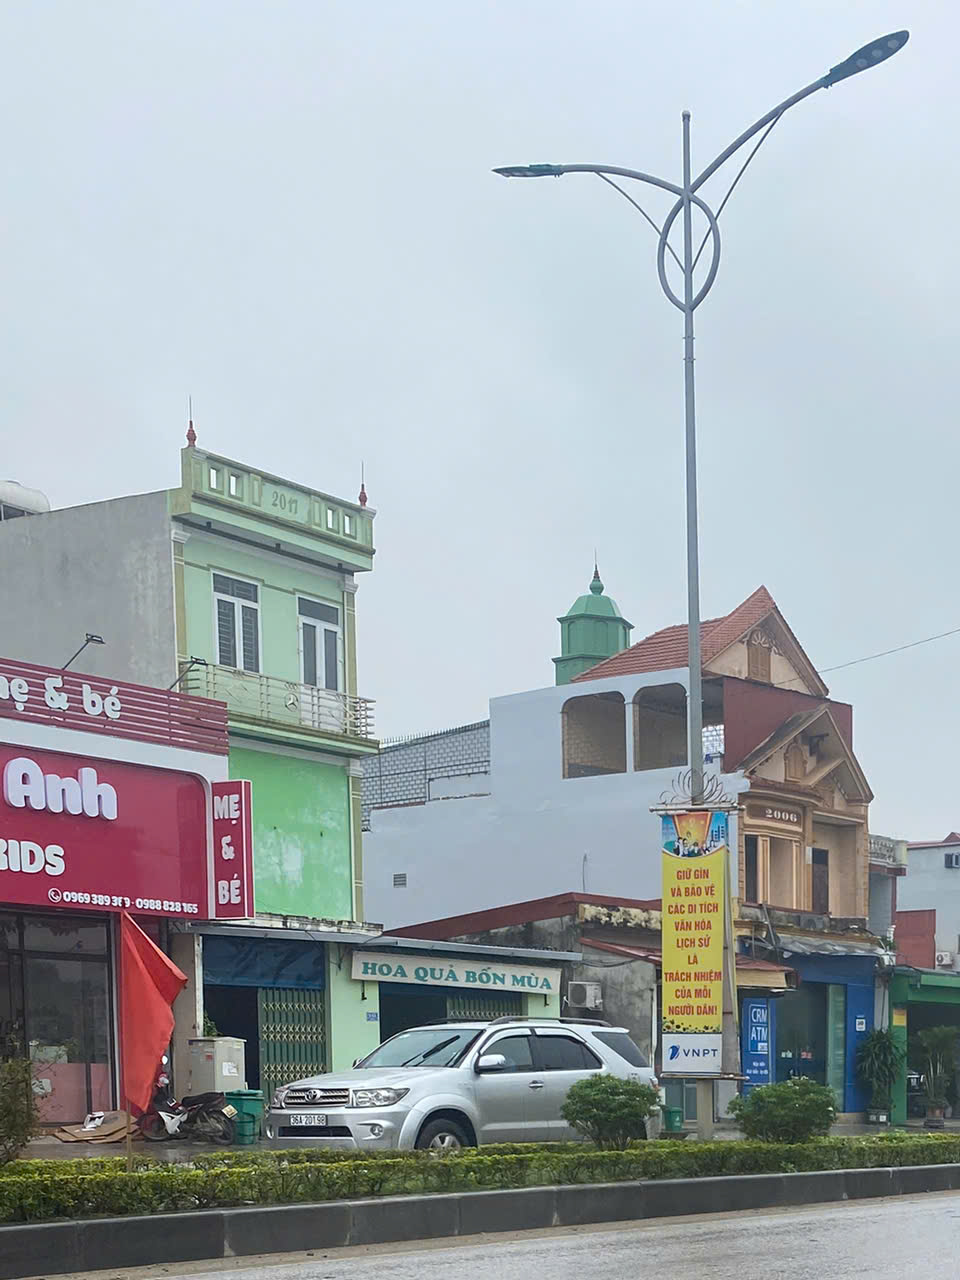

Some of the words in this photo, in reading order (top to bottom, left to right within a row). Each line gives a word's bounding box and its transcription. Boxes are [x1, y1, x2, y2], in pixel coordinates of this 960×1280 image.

[44, 675, 70, 710] &
[82, 684, 121, 719] bé
[3, 757, 118, 820] Anh
[213, 794, 240, 824] MẸ
[765, 808, 797, 822] 2006
[221, 835, 235, 860] &
[217, 873, 241, 904] BÉ
[670, 885, 682, 897] VÀ
[362, 961, 408, 978] HOA
[413, 964, 459, 982] QUẢ
[464, 966, 506, 985] BỐN
[511, 972, 552, 990] MÙA
[664, 970, 692, 983] TRÁCH
[674, 985, 692, 999] CỦA
[668, 1002, 694, 1016] NGƯỜI
[682, 1048, 718, 1058] VNPT
